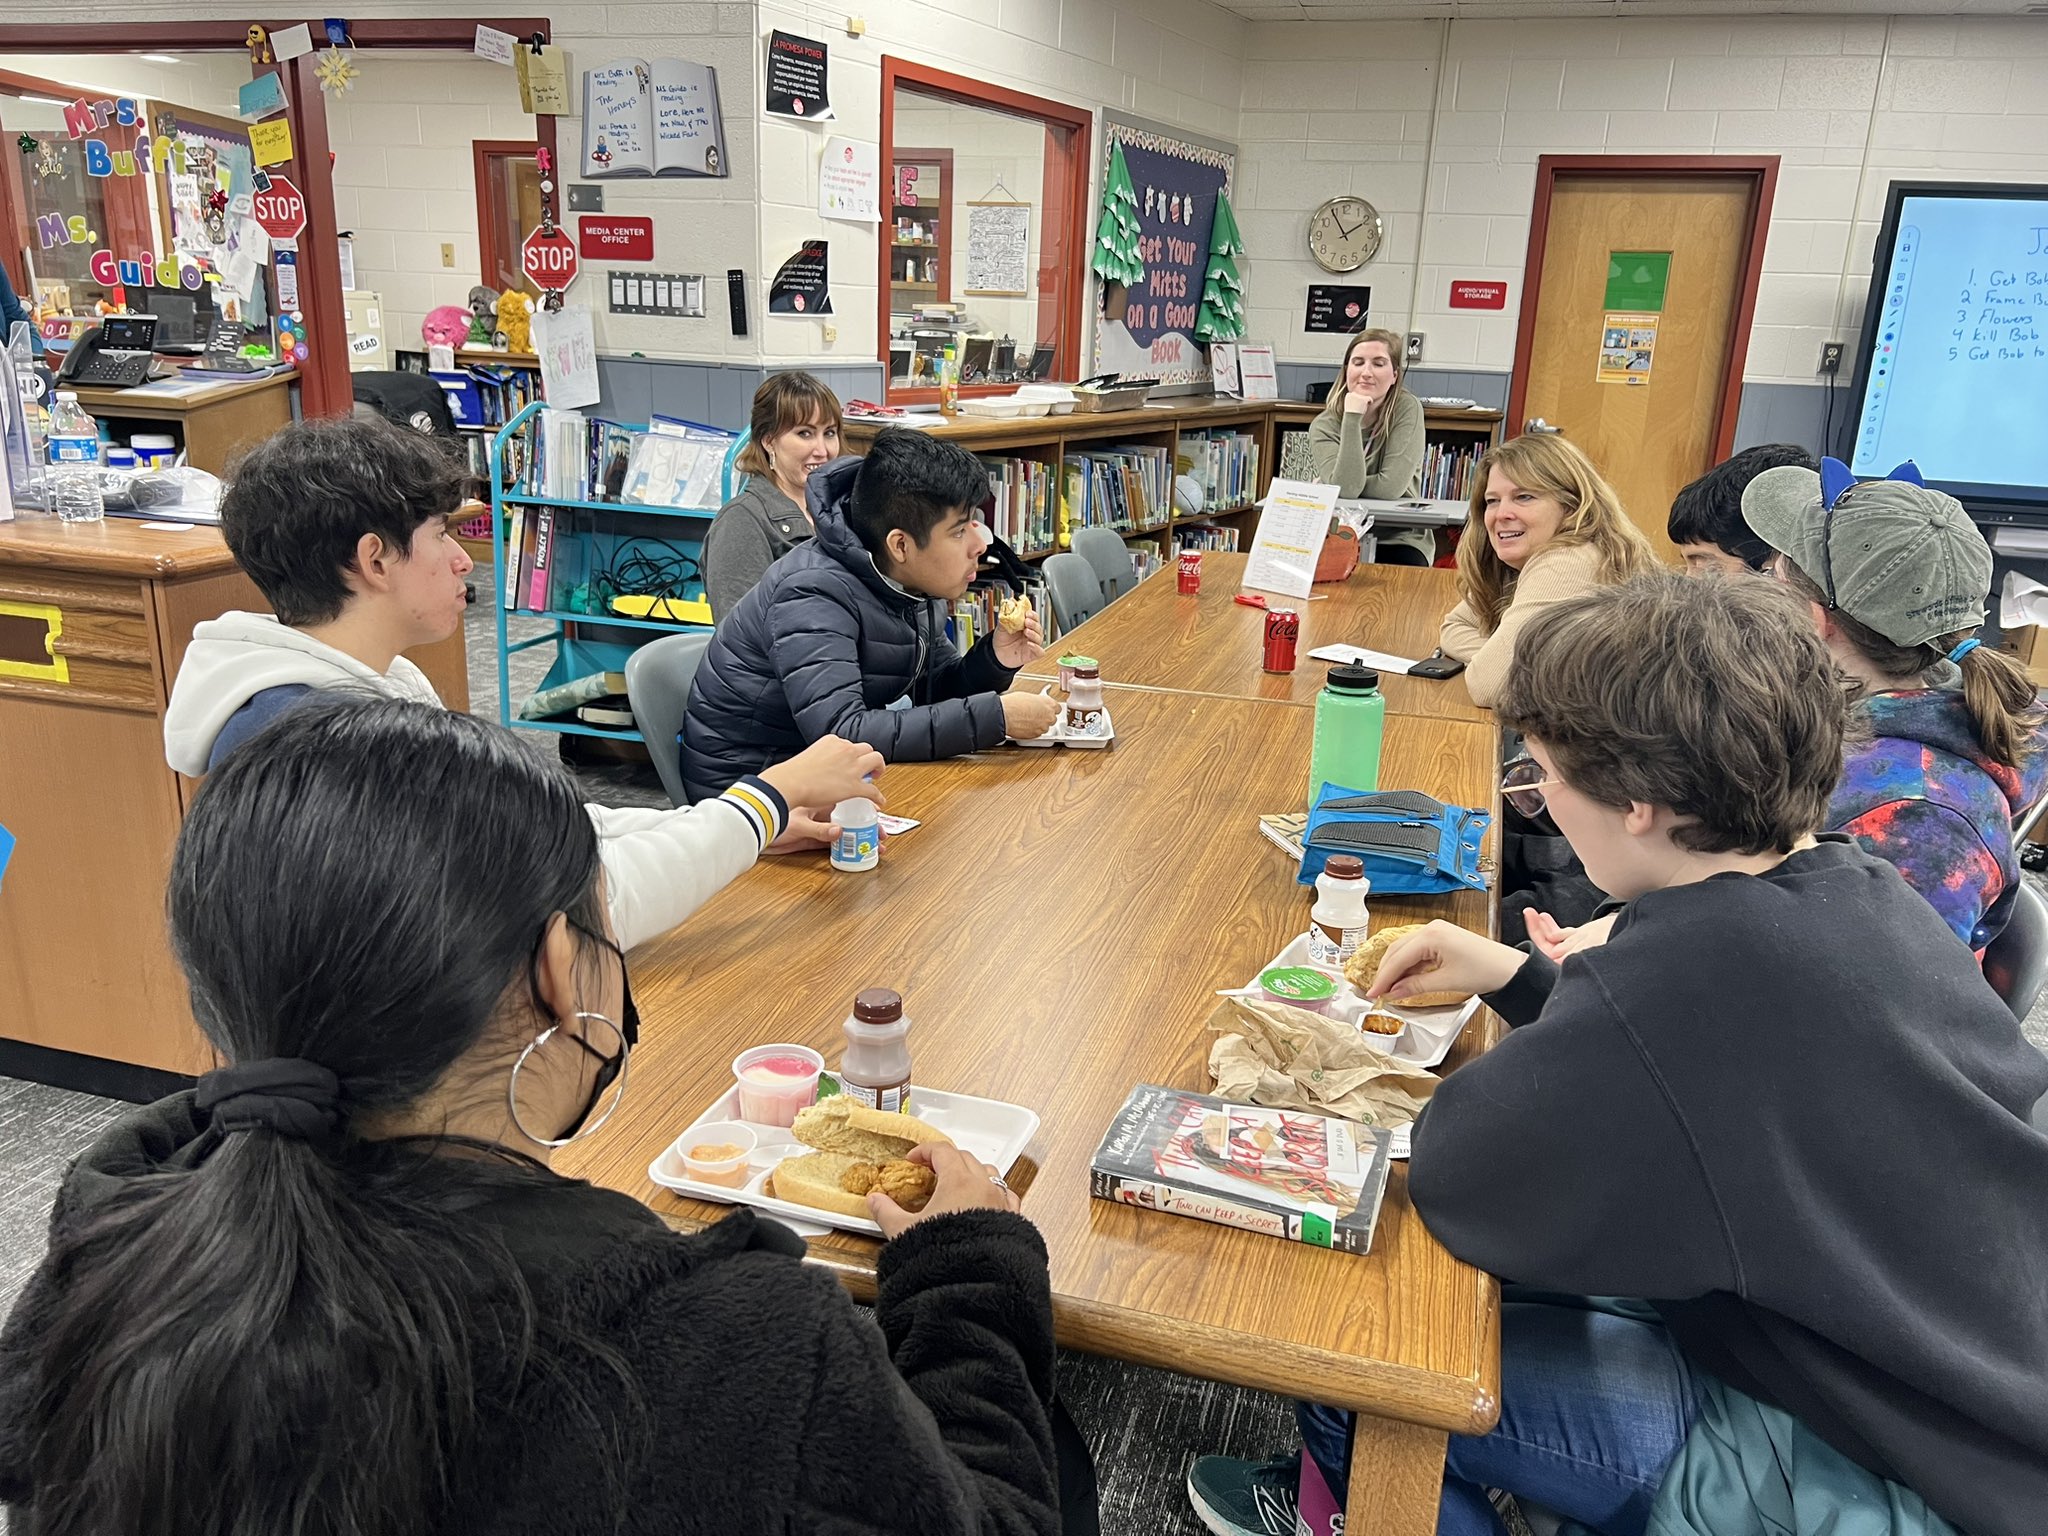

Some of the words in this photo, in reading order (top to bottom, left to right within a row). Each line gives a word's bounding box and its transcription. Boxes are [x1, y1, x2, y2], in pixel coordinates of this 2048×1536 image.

[596, 95, 613, 106] The
[63, 97, 145, 140] Mrs.
[85, 135, 186, 177] Buffi
[39, 162, 64, 178] HELLO
[256, 196, 301, 220] STOP
[1342, 204, 1352, 215] 12
[1321, 217, 1330, 228] 10
[1363, 215, 1370, 226] 2
[36, 212, 97, 249] Ms.
[585, 227, 610, 235] MEDIA
[613, 228, 645, 236] CENTER
[1315, 230, 1323, 241] 9
[1367, 229, 1374, 239] 3
[601, 236, 629, 244] OFFICE
[1138, 235, 1162, 263] Get
[1166, 235, 1197, 266] Your
[1320, 244, 1327, 254] 8
[1362, 244, 1368, 253] 4
[527, 246, 574, 271] STOP
[1330, 253, 1336, 263] 7
[1340, 255, 1347, 265] 6
[1352, 252, 1358, 262] 5
[90, 250, 202, 290] Guido
[1990, 270, 2017, 286] Get
[1149, 270, 1187, 298] Mitts
[1961, 289, 1971, 304] 2
[1985, 289, 2025, 305] Frame
[1127, 304, 1144, 329] on
[1149, 305, 1159, 329] a
[1165, 301, 1196, 329] Good
[1957, 308, 1967, 323] 3
[1978, 308, 2033, 324] Flowers
[1952, 327, 1964, 341] 4
[2009, 326, 2039, 341] Bob
[353, 337, 378, 353] READ
[1949, 346, 1958, 360] 5
[1969, 346, 1989, 360] Get
[1998, 346, 2024, 360] Bob
[536, 534, 547, 568] PROJECT
[1173, 1197, 1193, 1211] TWO
[1195, 1203, 1211, 1214] CAN
[1214, 1207, 1235, 1220] KEEP
[1237, 1213, 1243, 1221] A
[1243, 1214, 1280, 1231] SECRET
